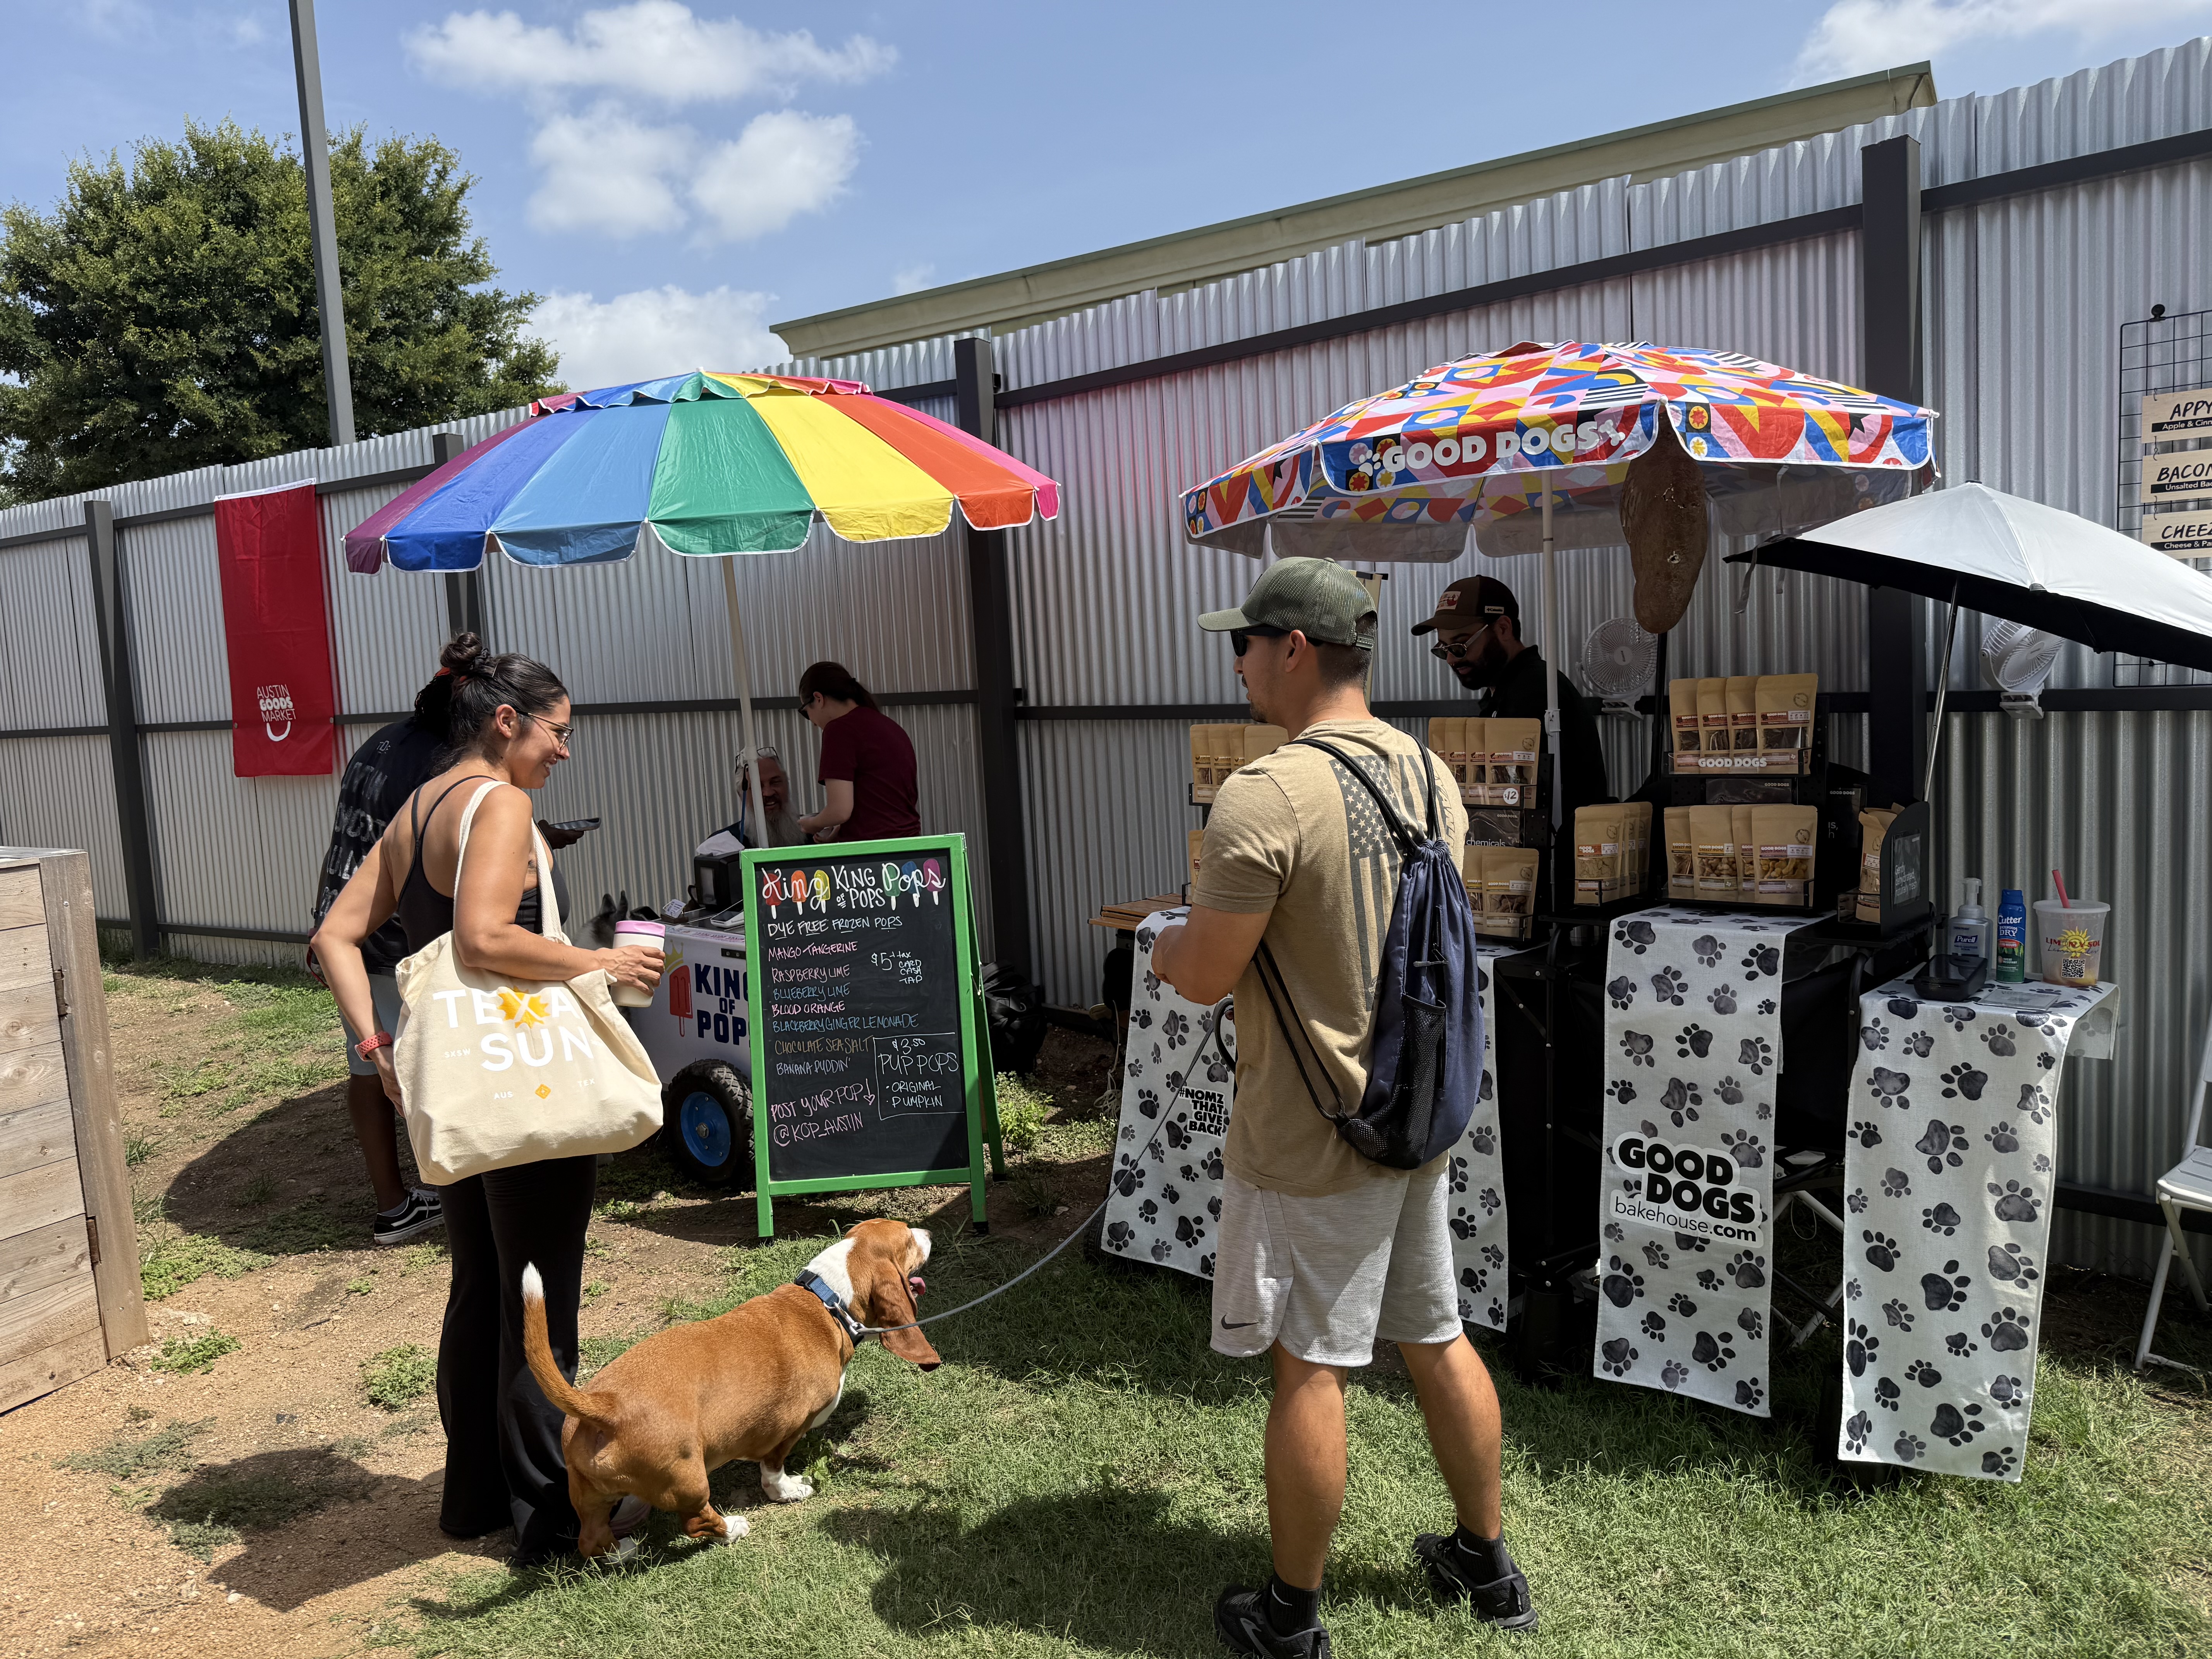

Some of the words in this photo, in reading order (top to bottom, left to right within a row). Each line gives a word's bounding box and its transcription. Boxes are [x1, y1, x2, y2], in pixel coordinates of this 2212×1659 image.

[2170, 400, 2212, 420] APPY
[2162, 422, 2185, 430] Apple
[1382, 436, 1487, 472] GOOD
[1496, 421, 1599, 459] DOGS
[2166, 481, 2198, 491] Unsalted
[257, 684, 290, 699] AUSTIN
[259, 696, 293, 711] GOODS
[261, 709, 296, 722] MARKET
[1698, 758, 1733, 767] GOOD
[1734, 757, 1767, 767] DOGS
[1504, 791, 1516, 800] $12
[1466, 837, 1506, 847] chemicals
[831, 865, 875, 892] KING
[882, 862, 946, 897] Pops
[762, 867, 829, 910] King
[836, 893, 845, 903] OF
[850, 887, 886, 908] POPS
[768, 921, 794, 937] DYE
[798, 919, 829, 933] FREE
[832, 917, 870, 931] FROZEN
[874, 916, 903, 928] POPS
[1998, 915, 2022, 924] Cutter
[768, 945, 802, 962] MANGO
[803, 941, 858, 956] TANGERINE
[871, 953, 892, 970] $5
[899, 959, 922, 968] CARD
[772, 967, 827, 983] RASPBERRY
[829, 964, 850, 977] LIME
[900, 966, 922, 975] CASH
[899, 975, 922, 984] TAP
[773, 986, 826, 1001] BLUEBERRY
[827, 982, 850, 997] LIME
[433, 986, 587, 1029] TEXA
[719, 997, 736, 1015] OF
[772, 1003, 801, 1017] BLOOD
[803, 1001, 845, 1013] ORANGE
[697, 1010, 750, 1046] POP
[773, 1018, 825, 1033] BLACKBERRY
[826, 1017, 860, 1030] GINGER
[862, 1013, 919, 1029] LEMONADE
[444, 1048, 471, 1059] SXSW
[481, 1026, 594, 1072] SUN
[775, 1037, 824, 1055] CHOCOLATE
[826, 1039, 844, 1053] SEA
[844, 1035, 874, 1053] SALT
[892, 1038, 926, 1054] $3.50
[776, 1062, 812, 1075] BANANA
[814, 1058, 851, 1075] PUDDIN'
[878, 1053, 913, 1075] PUP
[917, 1052, 959, 1075] POPS
[577, 1078, 596, 1088] TEX
[891, 1080, 941, 1093] ORIGINAL
[494, 1091, 514, 1100] AUS
[892, 1095, 943, 1108] PUMPKIN
[1180, 1087, 1224, 1104] #NOMZ
[771, 1101, 798, 1122] POST
[802, 1089, 833, 1116] YOUR
[1192, 1099, 1224, 1115] THAT
[1194, 1111, 1223, 1126] GIVE
[773, 1111, 864, 1147] @KOP_AUSTIN
[1189, 1120, 1222, 1137] BACK
[1618, 1138, 1733, 1186] GOOD
[1646, 1172, 1755, 1224] DOGS
[1615, 1196, 1756, 1242] bakehouse.com
